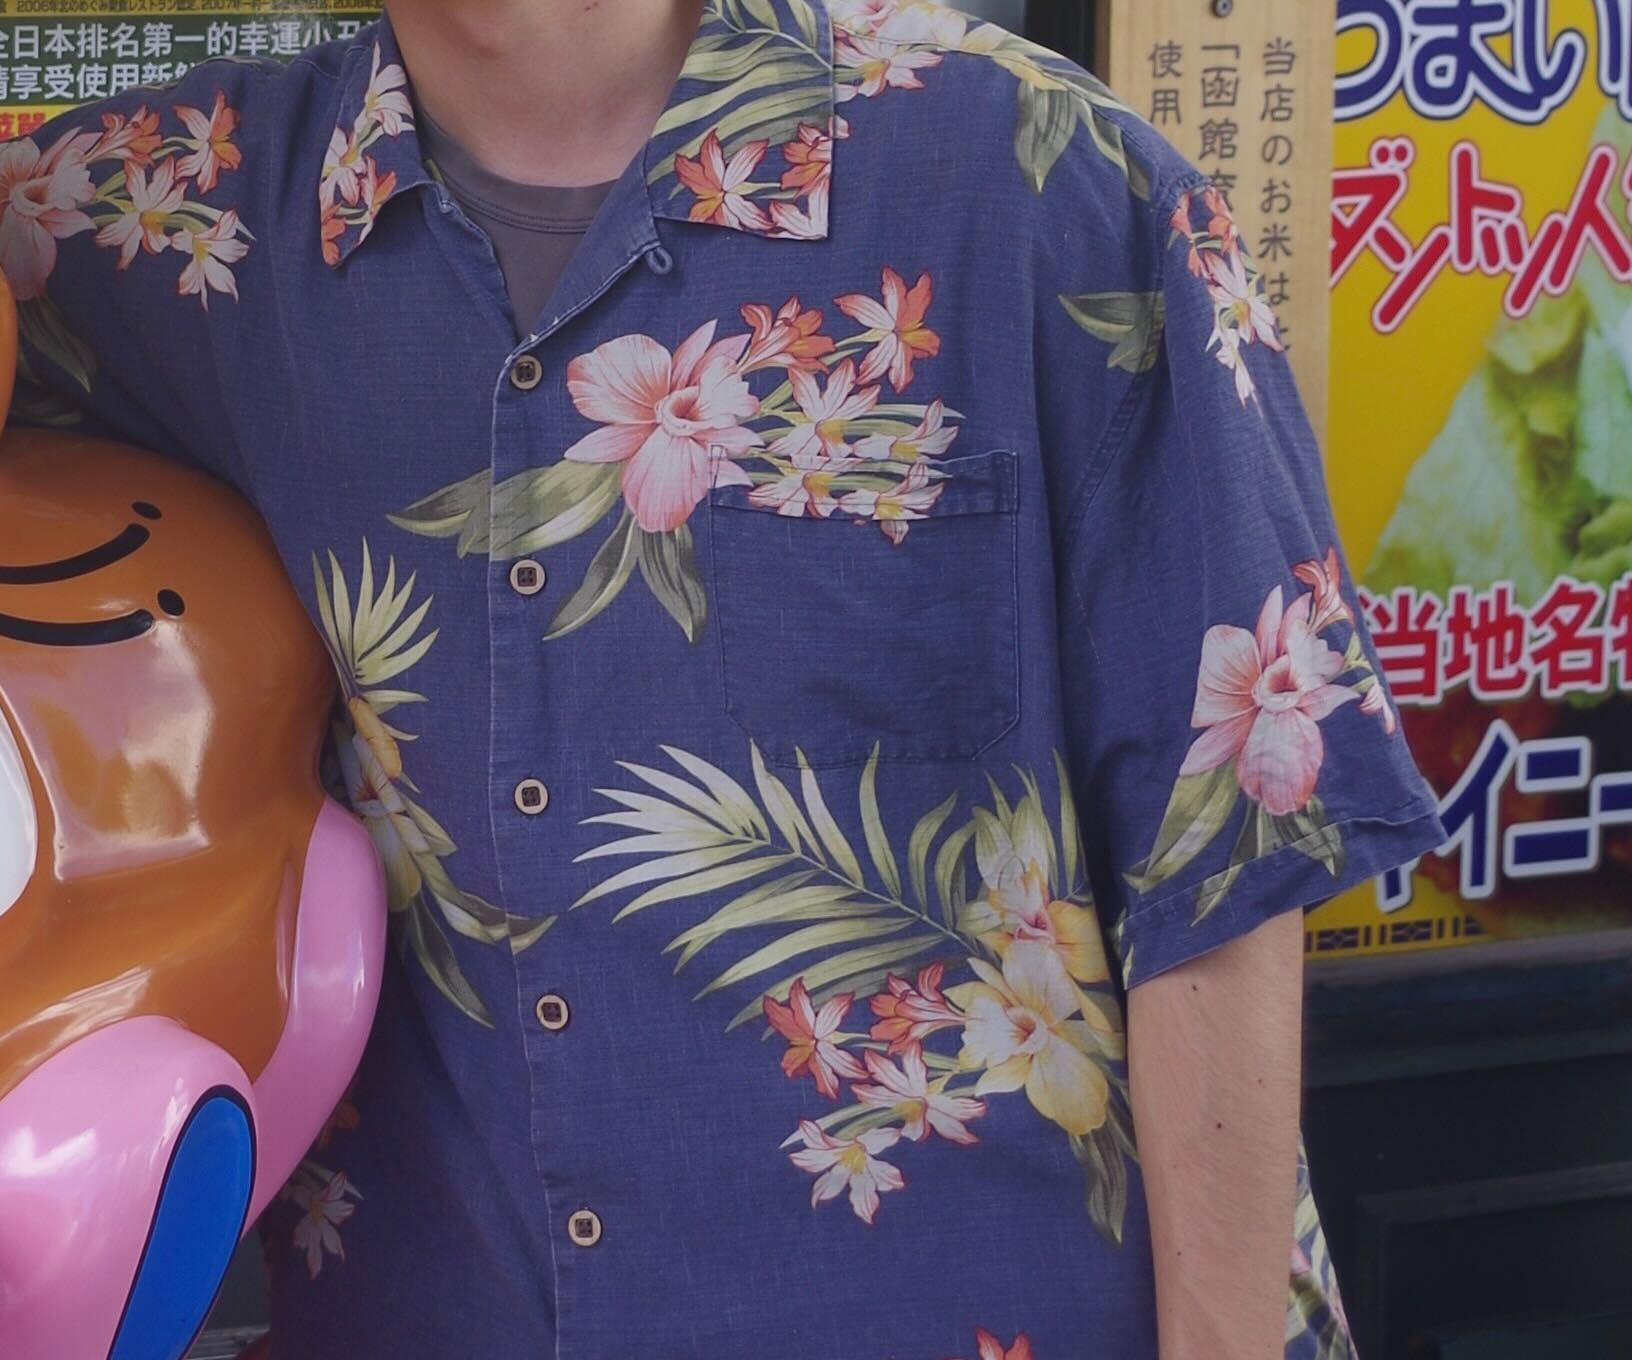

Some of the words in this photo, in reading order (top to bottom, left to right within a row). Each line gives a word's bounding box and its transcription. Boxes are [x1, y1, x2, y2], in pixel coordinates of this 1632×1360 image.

[1330, 136, 1632, 333] ダントツ人
[1358, 575, 1632, 705] 当地名
[1374, 718, 1632, 912] イニ
